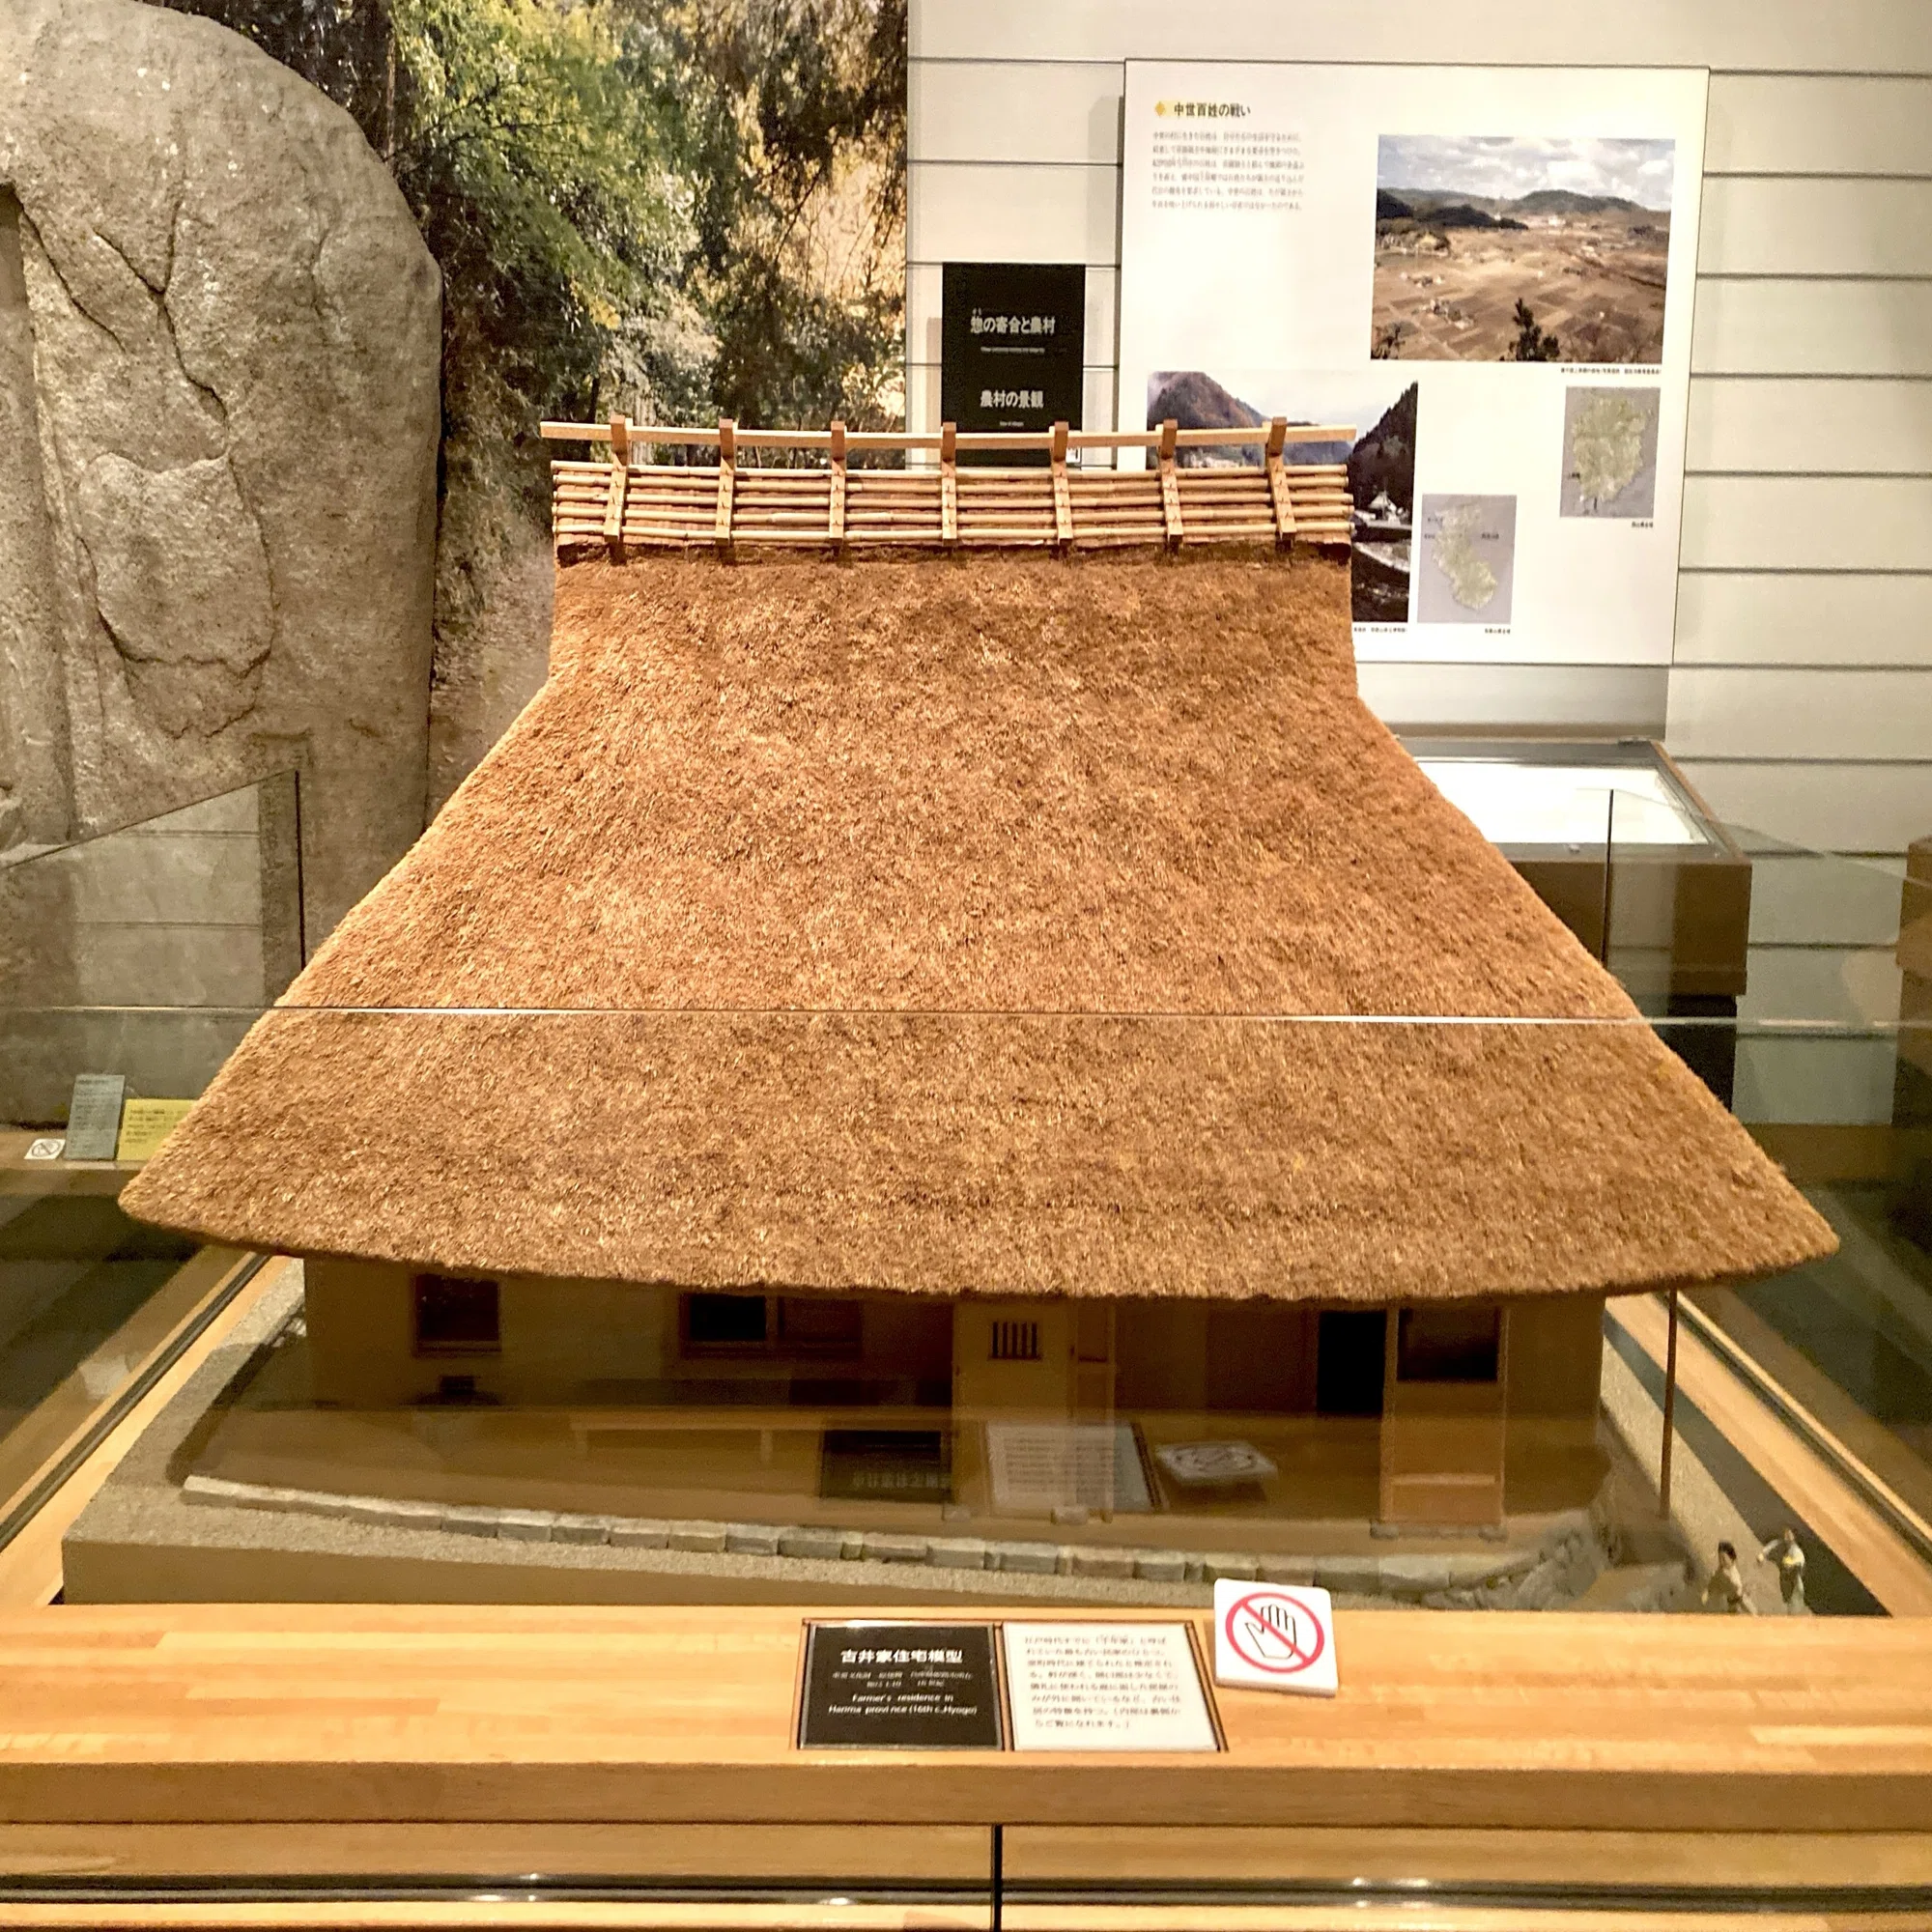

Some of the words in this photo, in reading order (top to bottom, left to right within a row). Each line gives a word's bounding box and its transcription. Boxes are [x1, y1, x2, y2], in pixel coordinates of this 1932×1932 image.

[1174, 101, 1251, 118] 中世百姓の戦い
[980, 389, 1044, 409] 農村の景観
[852, 1693, 892, 1703] Farmer's
[897, 1693, 941, 1703] residence
[944, 1693, 954, 1702] in
